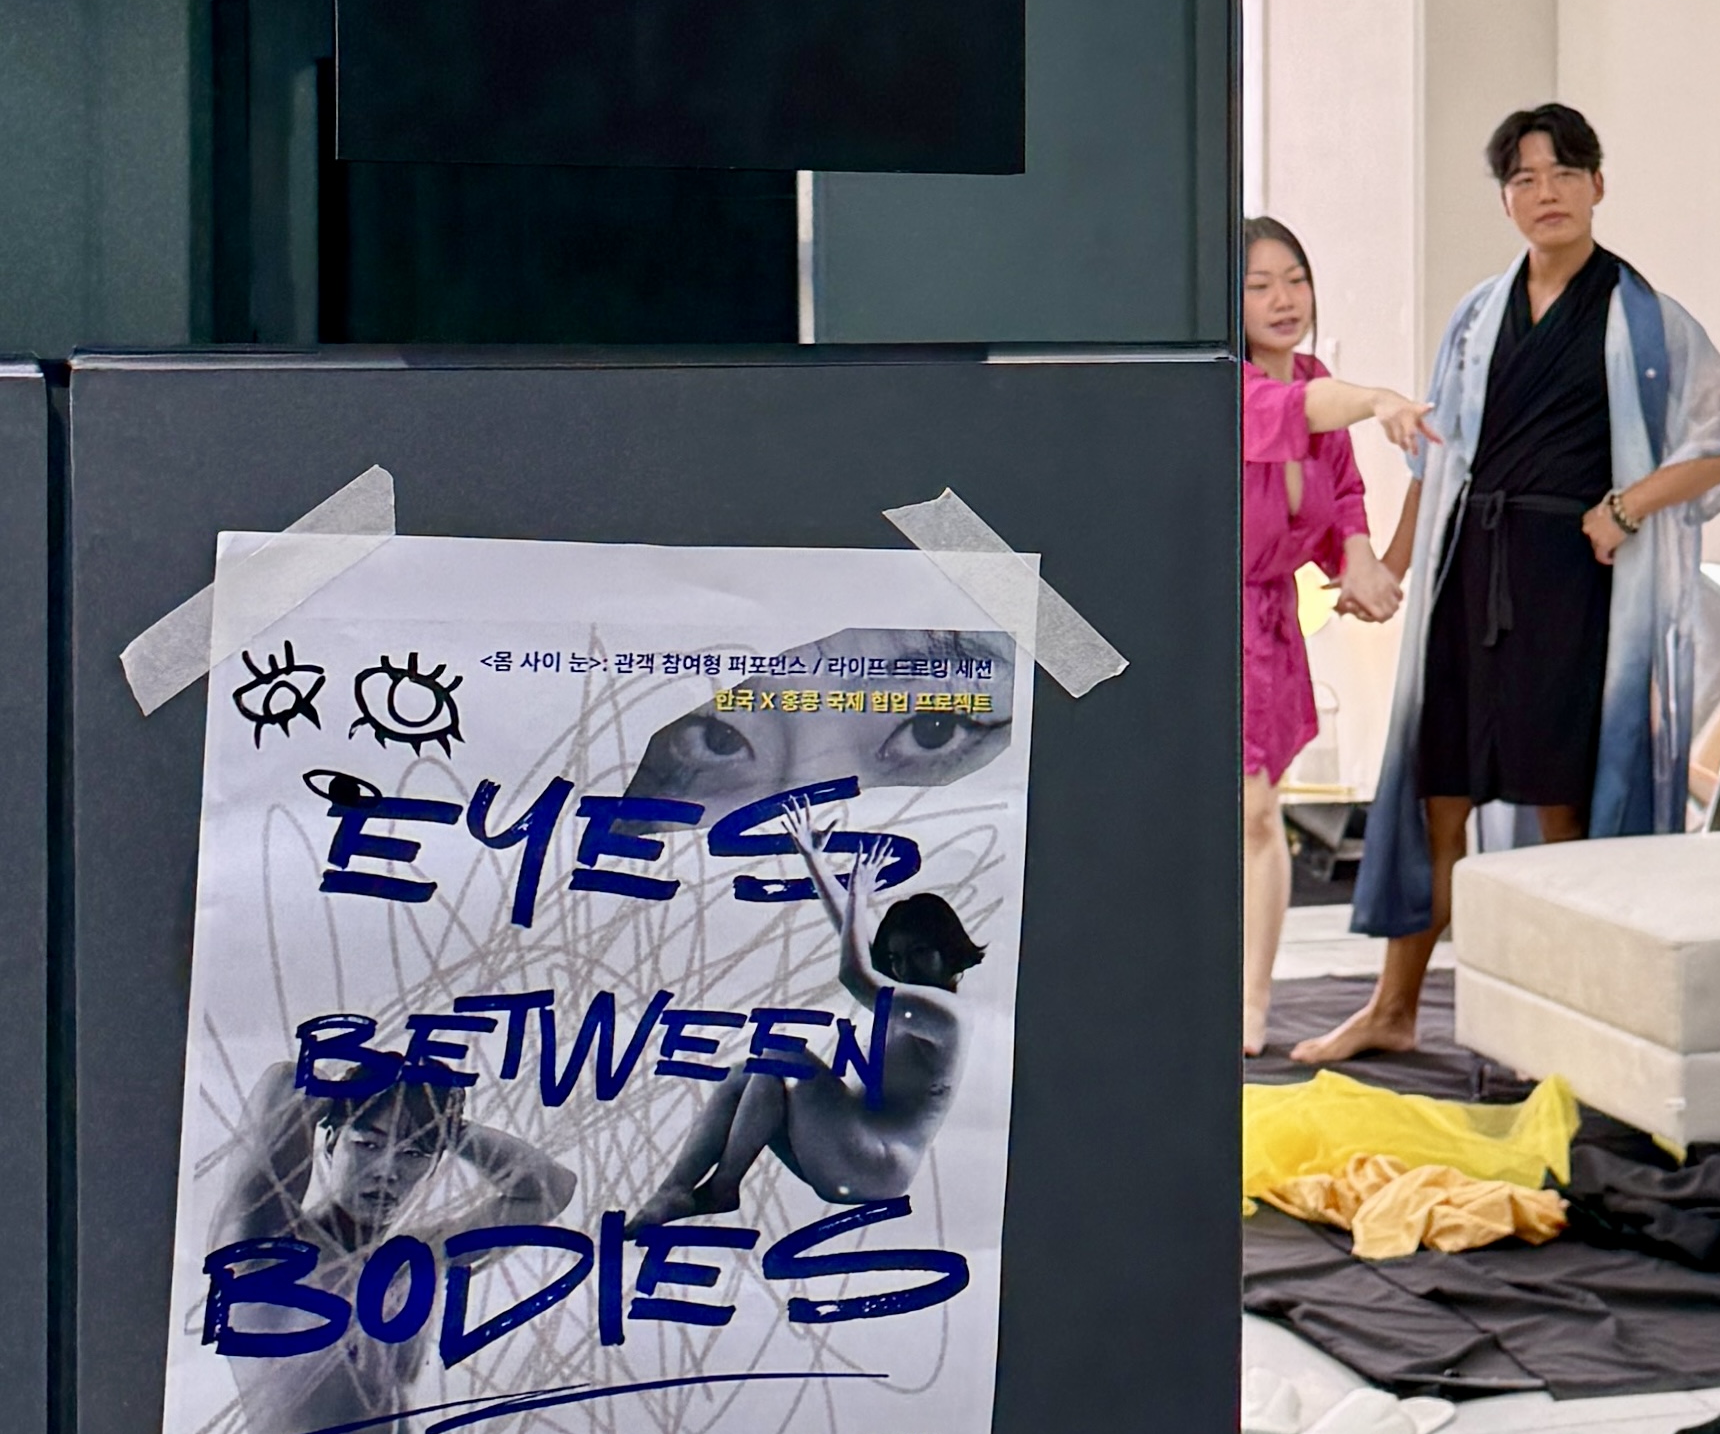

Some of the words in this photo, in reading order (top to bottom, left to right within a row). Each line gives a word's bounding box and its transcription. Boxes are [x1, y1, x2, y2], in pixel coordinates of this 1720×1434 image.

[480, 651, 513, 672] <몸
[520, 651, 560, 673] 사이
[569, 652, 608, 674] 눈>:
[614, 652, 655, 675] 관객
[662, 653, 721, 676] 참여형
[728, 656, 807, 676] 퍼포먼스
[812, 658, 821, 675] /
[828, 657, 887, 678] 라이프
[892, 658, 949, 679] 드로잉
[956, 658, 993, 679] 세션
[715, 689, 755, 712] 한국
[760, 692, 775, 710] X
[781, 689, 820, 712] 홍콩
[826, 690, 866, 712] 국제
[871, 690, 909, 712] 협업
[915, 691, 993, 714] 프로젝트
[319, 775, 922, 928] EYES
[295, 986, 896, 1110] BETWEEN
[201, 1195, 970, 1369] BODIES
